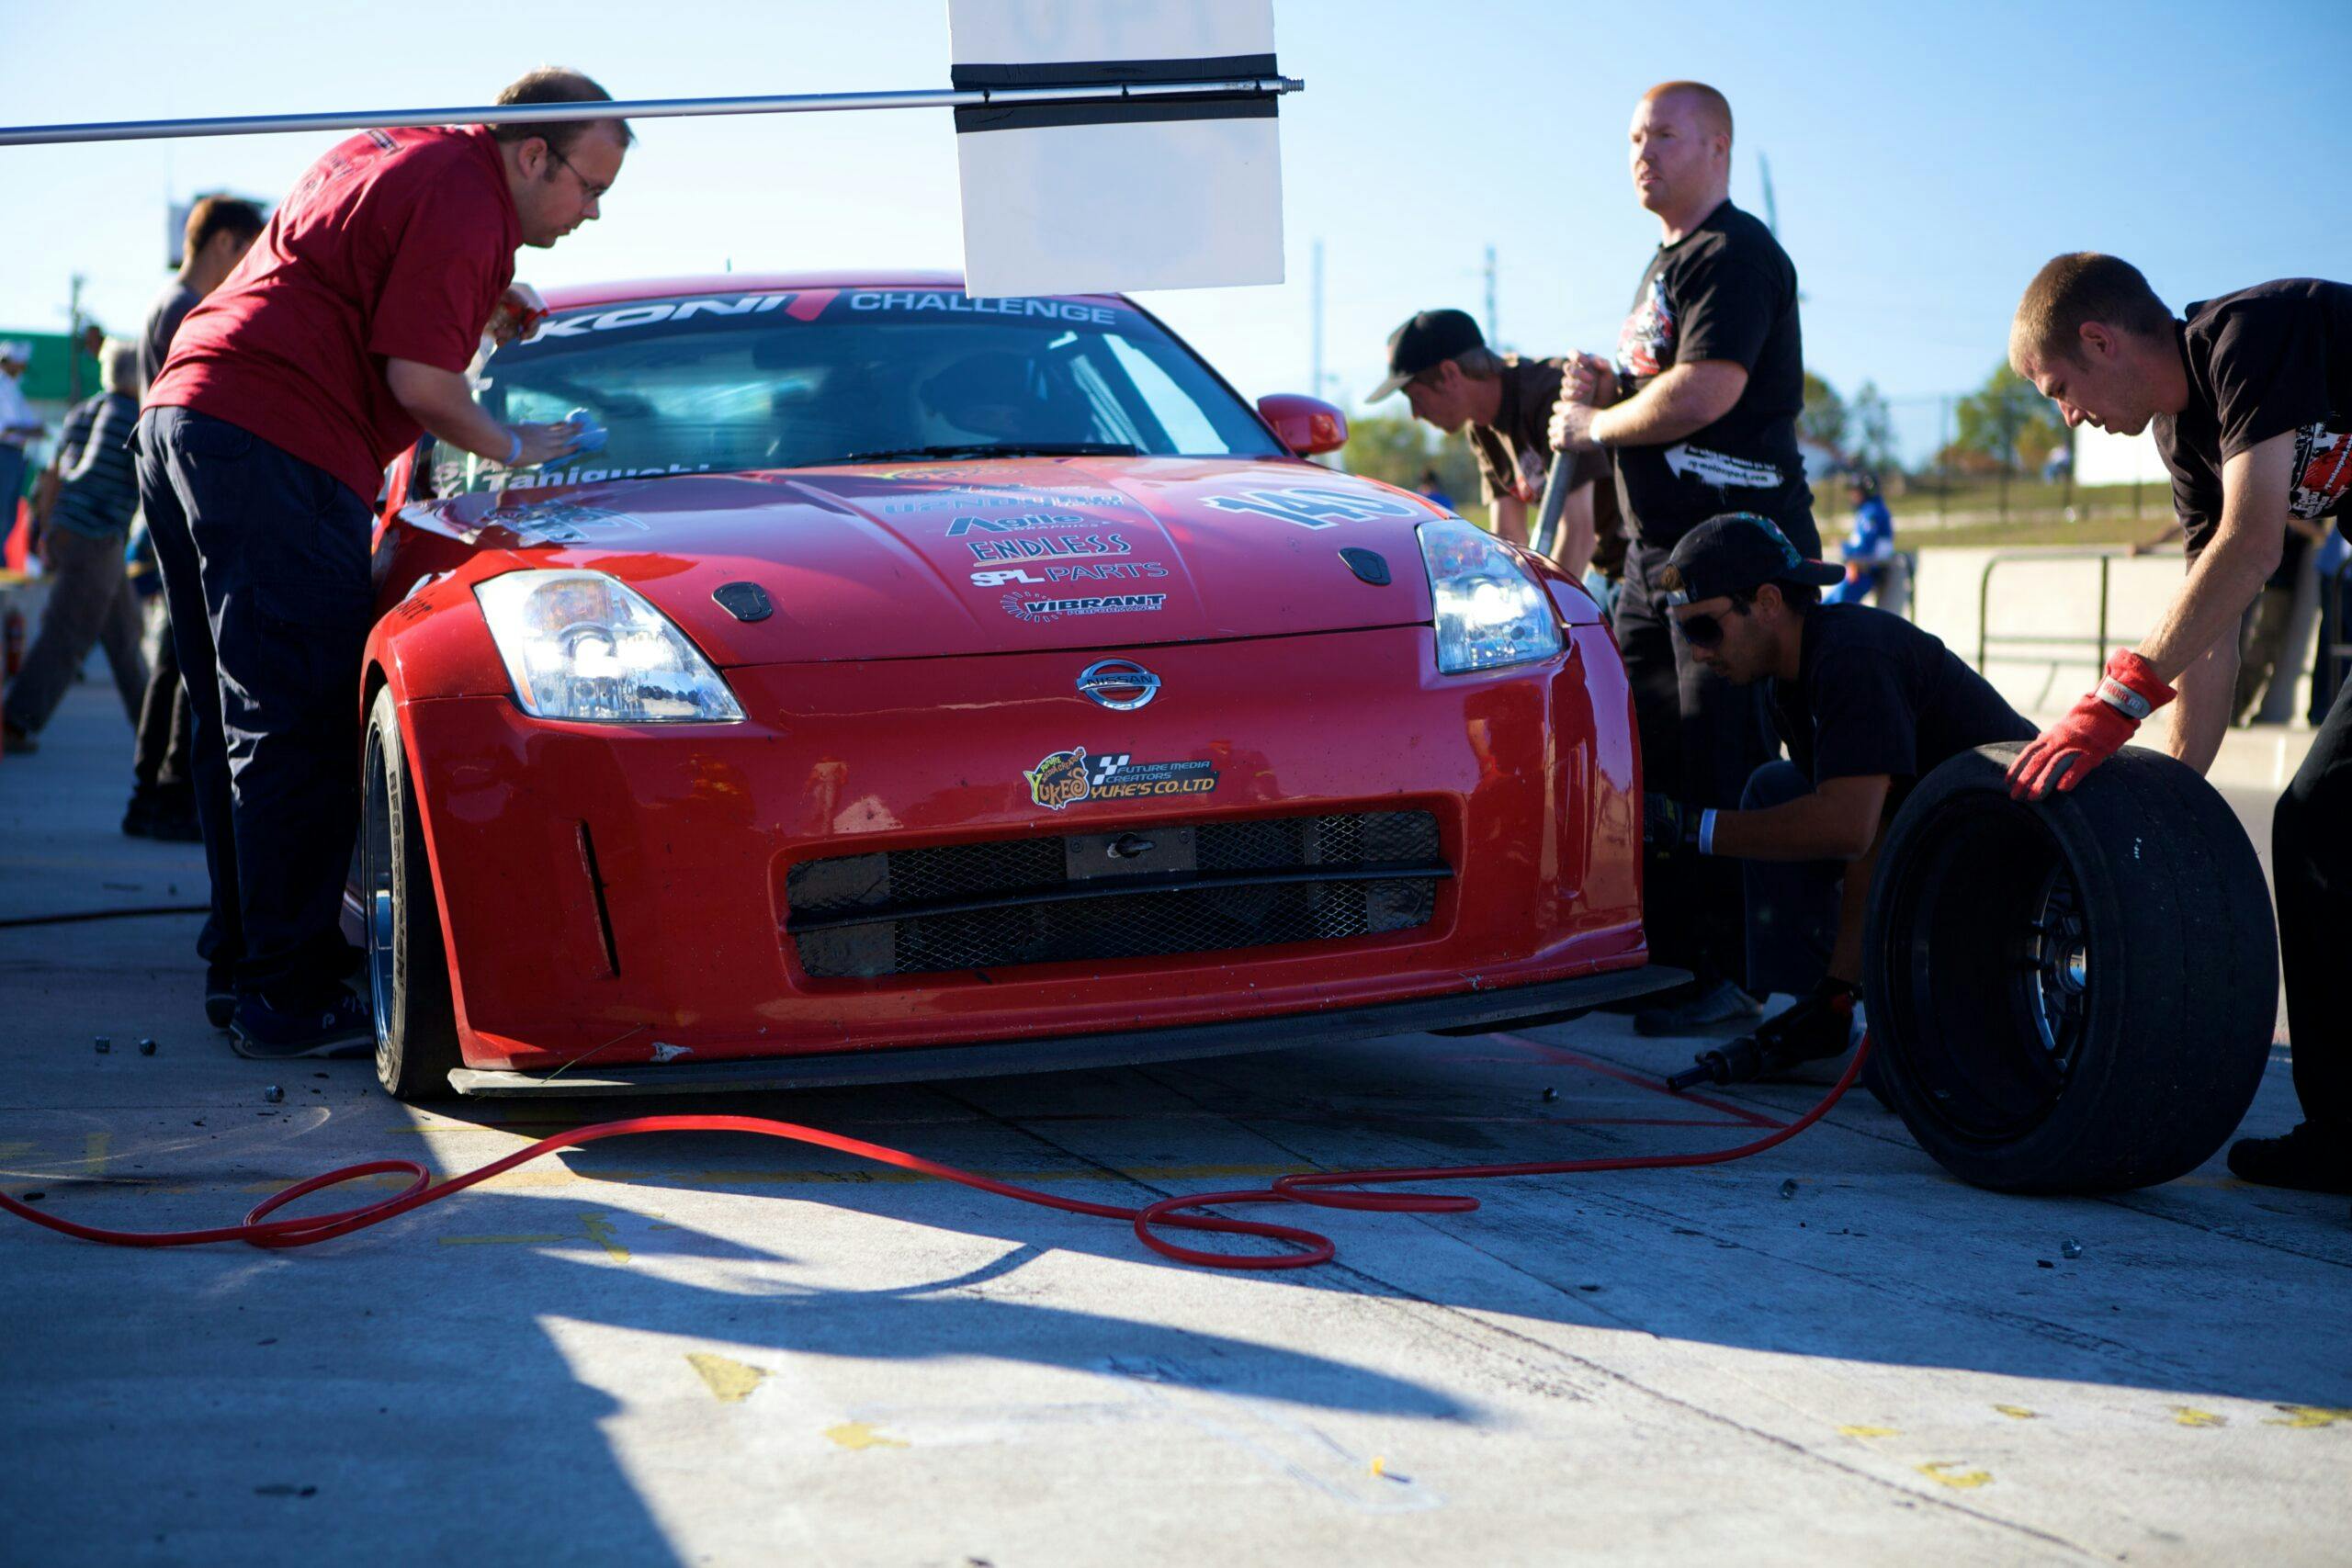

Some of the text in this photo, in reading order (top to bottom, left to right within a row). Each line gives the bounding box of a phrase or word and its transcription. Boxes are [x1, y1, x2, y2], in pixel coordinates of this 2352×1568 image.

[519, 295, 786, 345] KONI
[850, 292, 1117, 325] CHALLENGE
[1197, 487, 1419, 530] 140
[945, 513, 1084, 536] Agile
[967, 534, 1132, 562] ENDLESS
[970, 562, 1169, 587] SPL PARTS
[1024, 593, 1167, 613] VIBRANT
[1086, 675, 1153, 686] NISSAN
[1105, 772, 1172, 784] CREATORS
[1116, 761, 1211, 774] FUTURE MEDIA
[1090, 782, 1154, 799] YUKE'S
